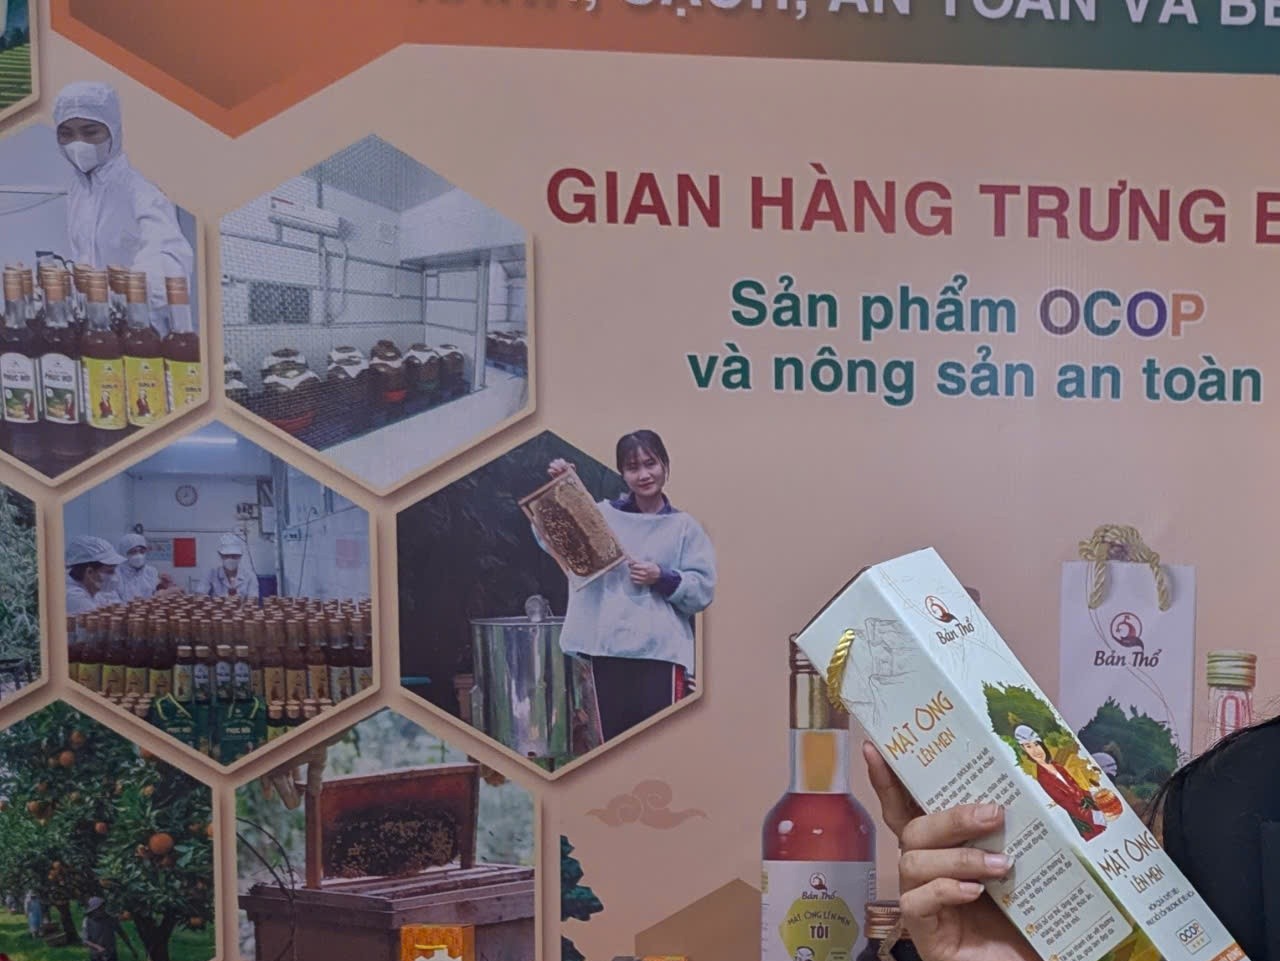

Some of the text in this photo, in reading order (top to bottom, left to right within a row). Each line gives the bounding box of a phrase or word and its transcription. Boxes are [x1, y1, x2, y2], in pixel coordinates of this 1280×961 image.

[546, 168, 721, 229] GIAN
[751, 162, 953, 236] HÀNG
[979, 180, 1226, 244] TRƯNG
[731, 275, 1205, 341] Sản phẩm OCOP
[688, 343, 1262, 407] và nông sản an toàn
[936, 628, 959, 645] Bản
[1094, 648, 1162, 668] Bản Thổ
[883, 722, 918, 760] MẬT
[916, 726, 956, 766] LÊN MEN
[1097, 848, 1129, 880] MẬT
[1133, 863, 1165, 894] LÊN MEN
[810, 922, 829, 939] TỎI
[1179, 922, 1200, 942] OCOP
